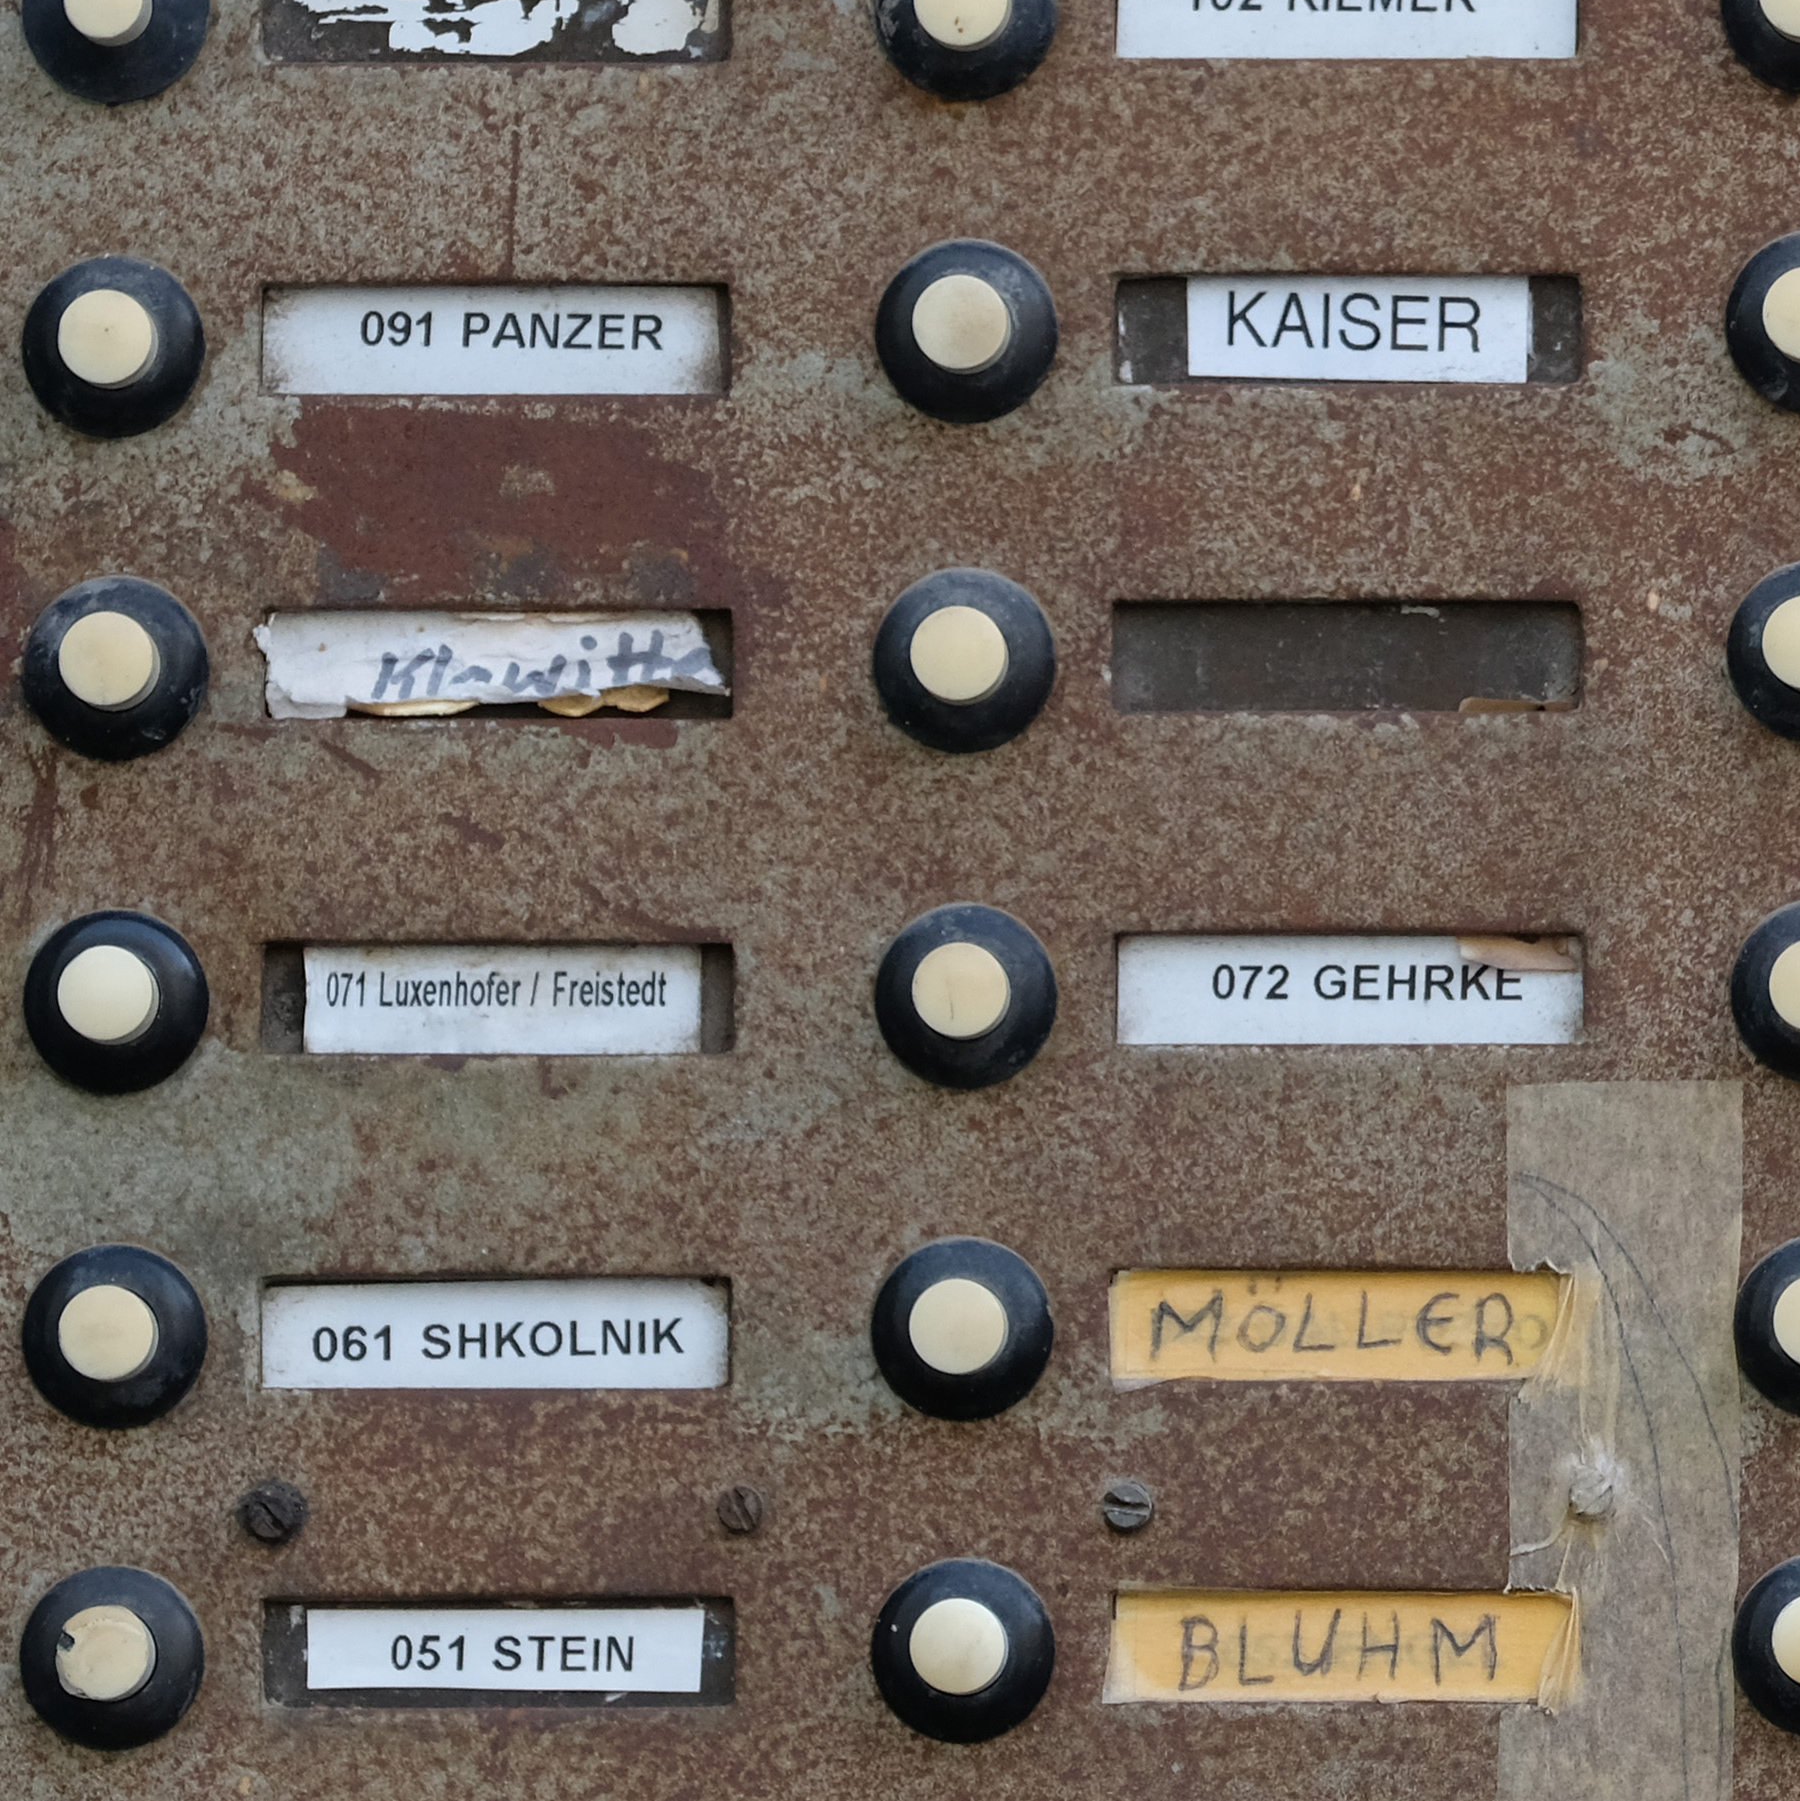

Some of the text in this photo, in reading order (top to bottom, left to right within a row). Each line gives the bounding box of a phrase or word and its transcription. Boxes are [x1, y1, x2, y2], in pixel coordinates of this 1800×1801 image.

[359, 310, 663, 351] 091 PANZER
[1226, 290, 1481, 353] KAISER
[325, 971, 667, 1007] 071 Luxenhofer / Freistedt
[1212, 964, 1523, 1001] 072 GEHRKE
[312, 1317, 684, 1362] 061 SHKOLNIK
[1150, 1276, 1514, 1364] MÖLLER
[391, 1635, 634, 1672] 051 STEIN
[1178, 1608, 1498, 1691] BLUHM
